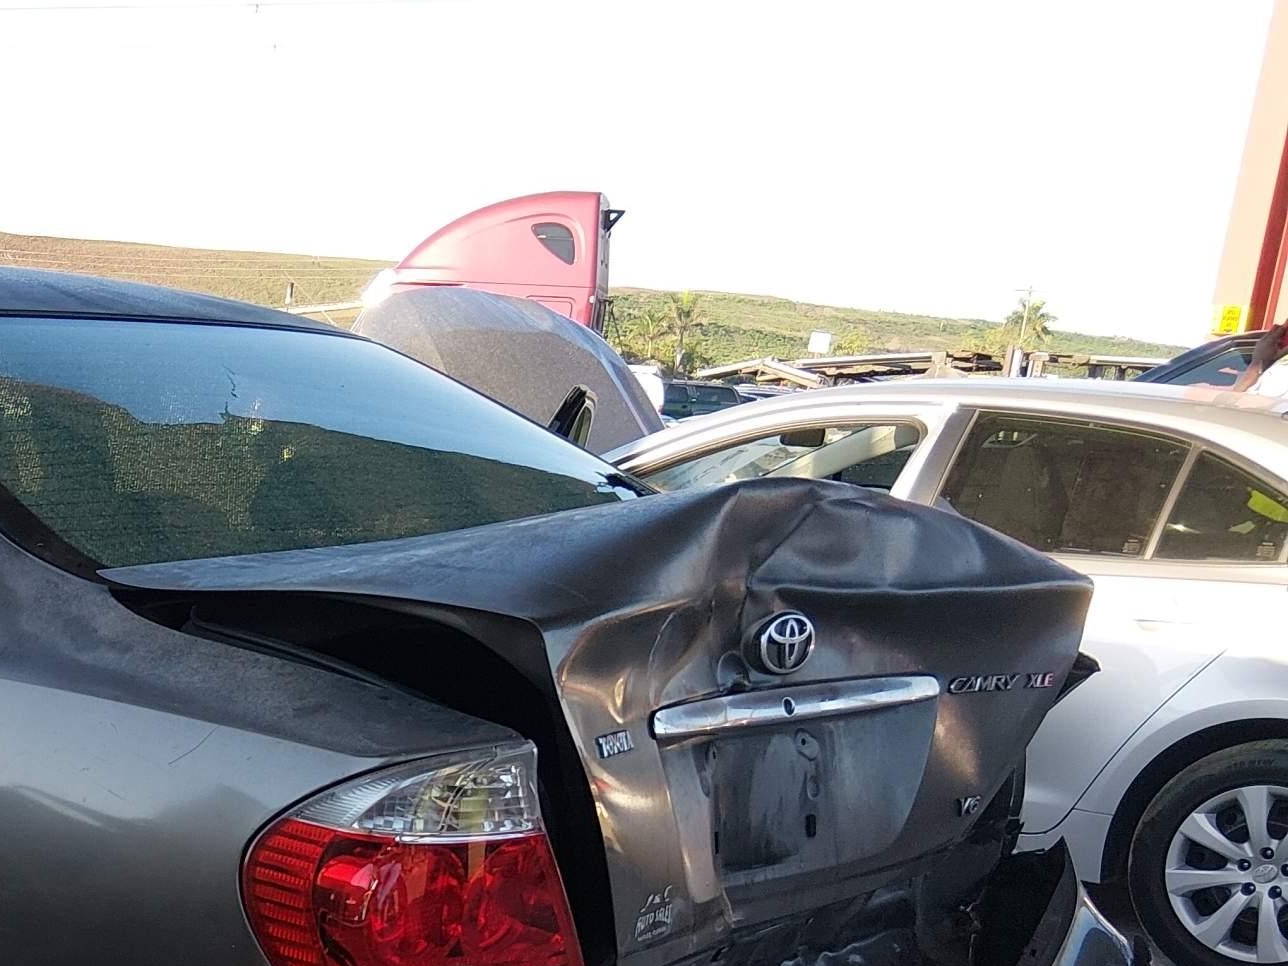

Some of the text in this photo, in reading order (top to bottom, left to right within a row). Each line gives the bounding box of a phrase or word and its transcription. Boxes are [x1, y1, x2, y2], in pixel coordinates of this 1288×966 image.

[950, 673, 1054, 693] CAMRY XLE
[959, 796, 981, 816] V6
